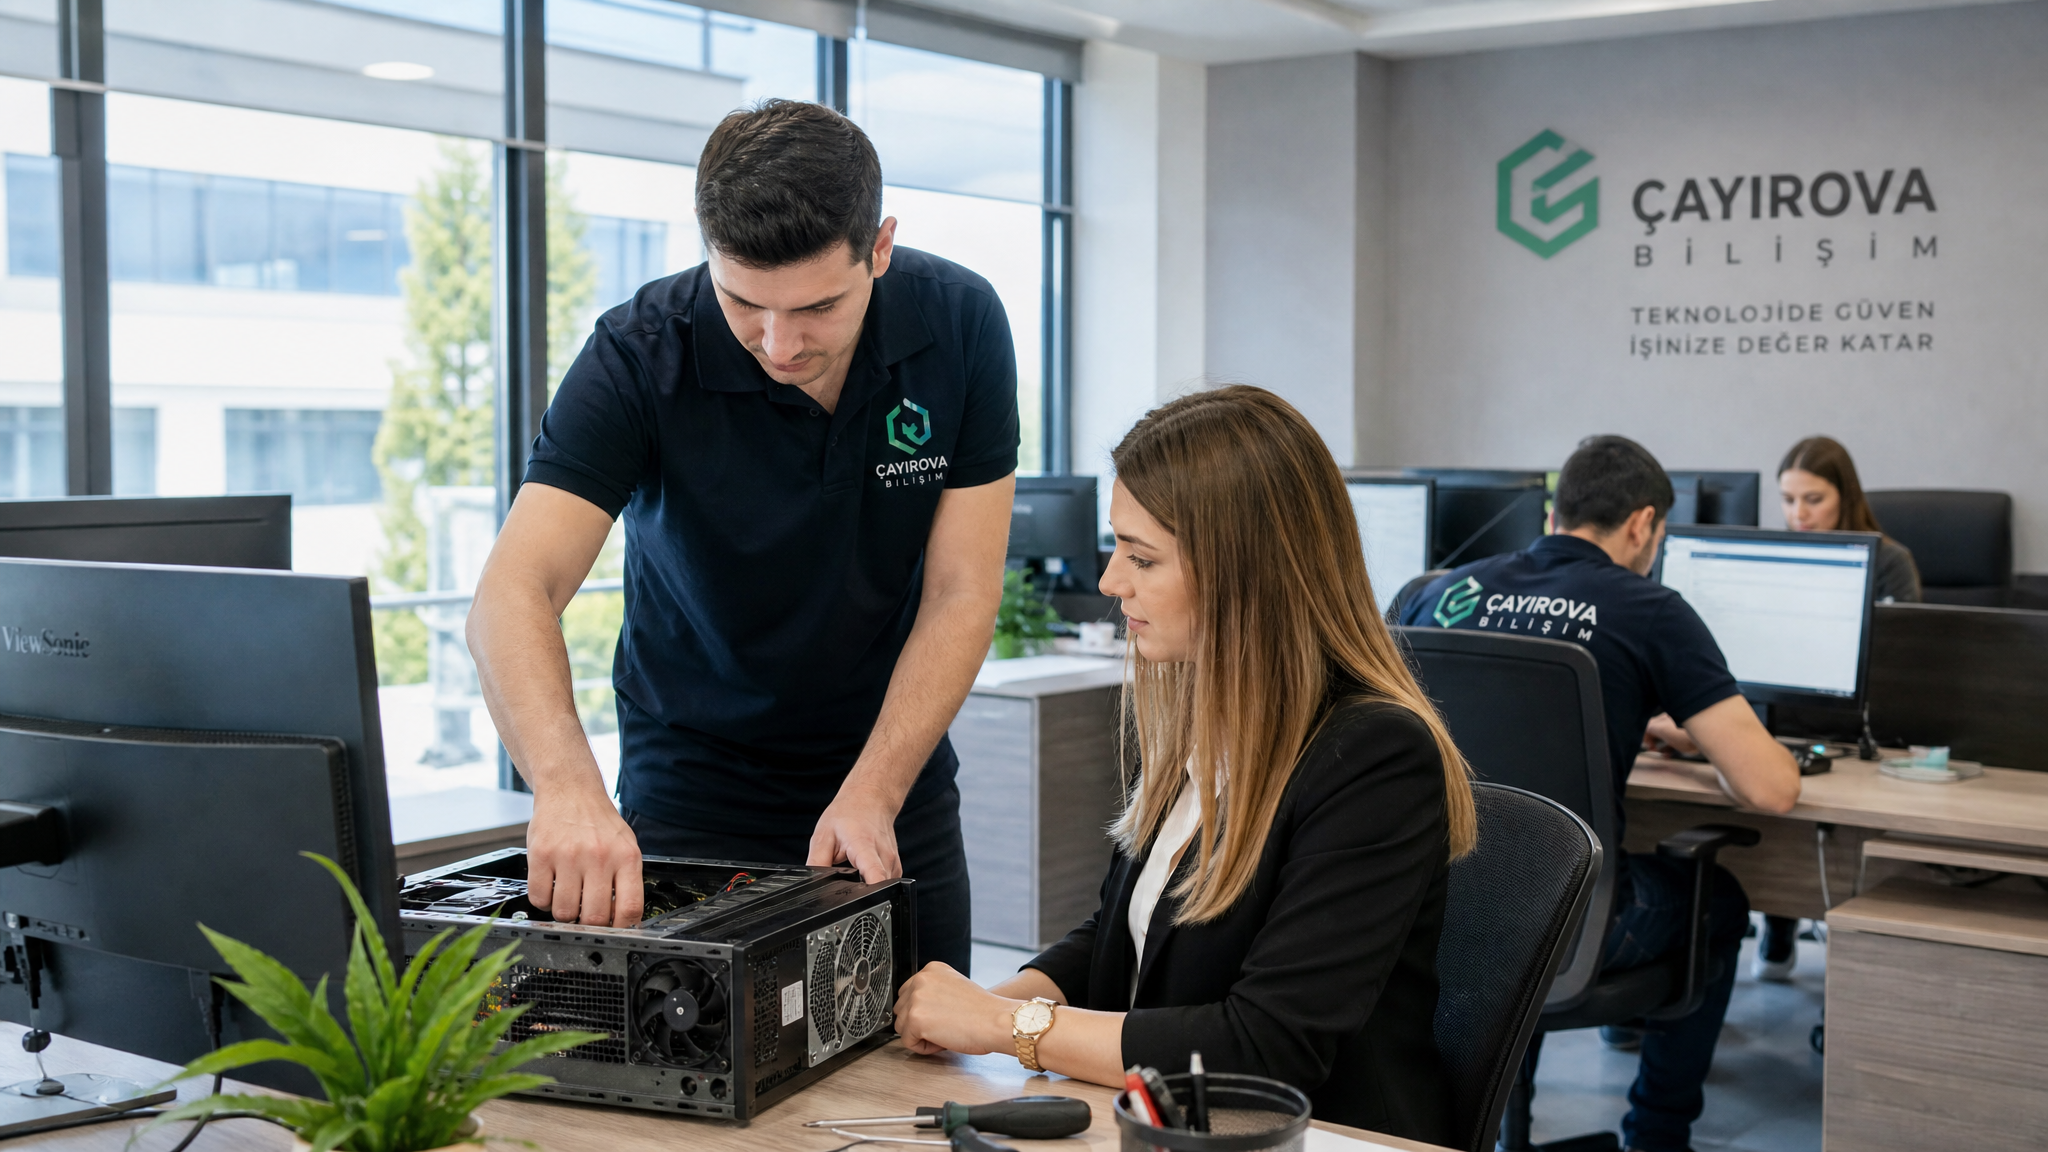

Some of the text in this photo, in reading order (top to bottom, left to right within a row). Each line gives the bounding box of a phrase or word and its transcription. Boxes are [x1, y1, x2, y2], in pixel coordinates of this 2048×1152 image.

[1632, 167, 1938, 235] ÇAYIROVA
[1634, 232, 1938, 267] BİLİŞİM
[1630, 298, 1935, 325] TEKNOLOJİDE GÜVEN
[1630, 331, 1933, 358] İŞİNİZE DEĞER KATAR
[876, 455, 948, 479] ÇAYIROVA
[1486, 594, 1597, 626] ÇAYIROVA
[2, 626, 90, 658] ViewSonic
